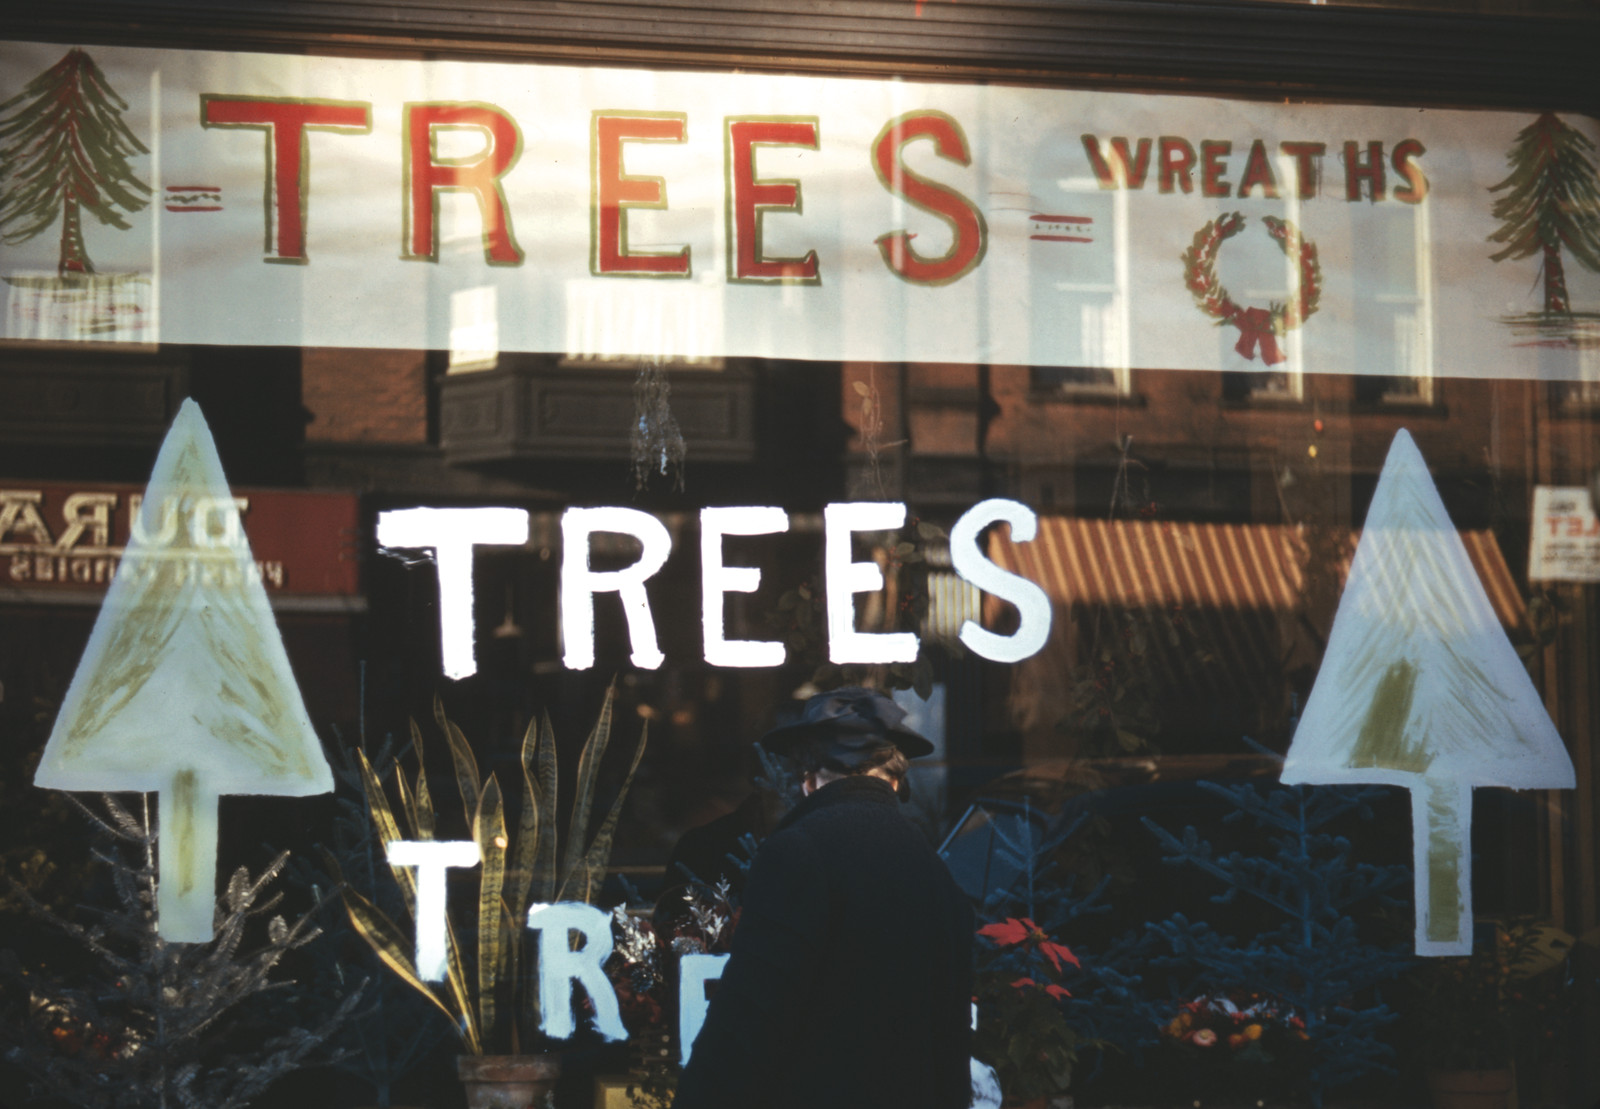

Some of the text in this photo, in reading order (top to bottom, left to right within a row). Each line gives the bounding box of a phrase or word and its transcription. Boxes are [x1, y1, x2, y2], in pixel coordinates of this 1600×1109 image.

[200, 93, 988, 287] TREES
[1081, 133, 1430, 204] WREATHS
[377, 498, 1051, 680] TREES
